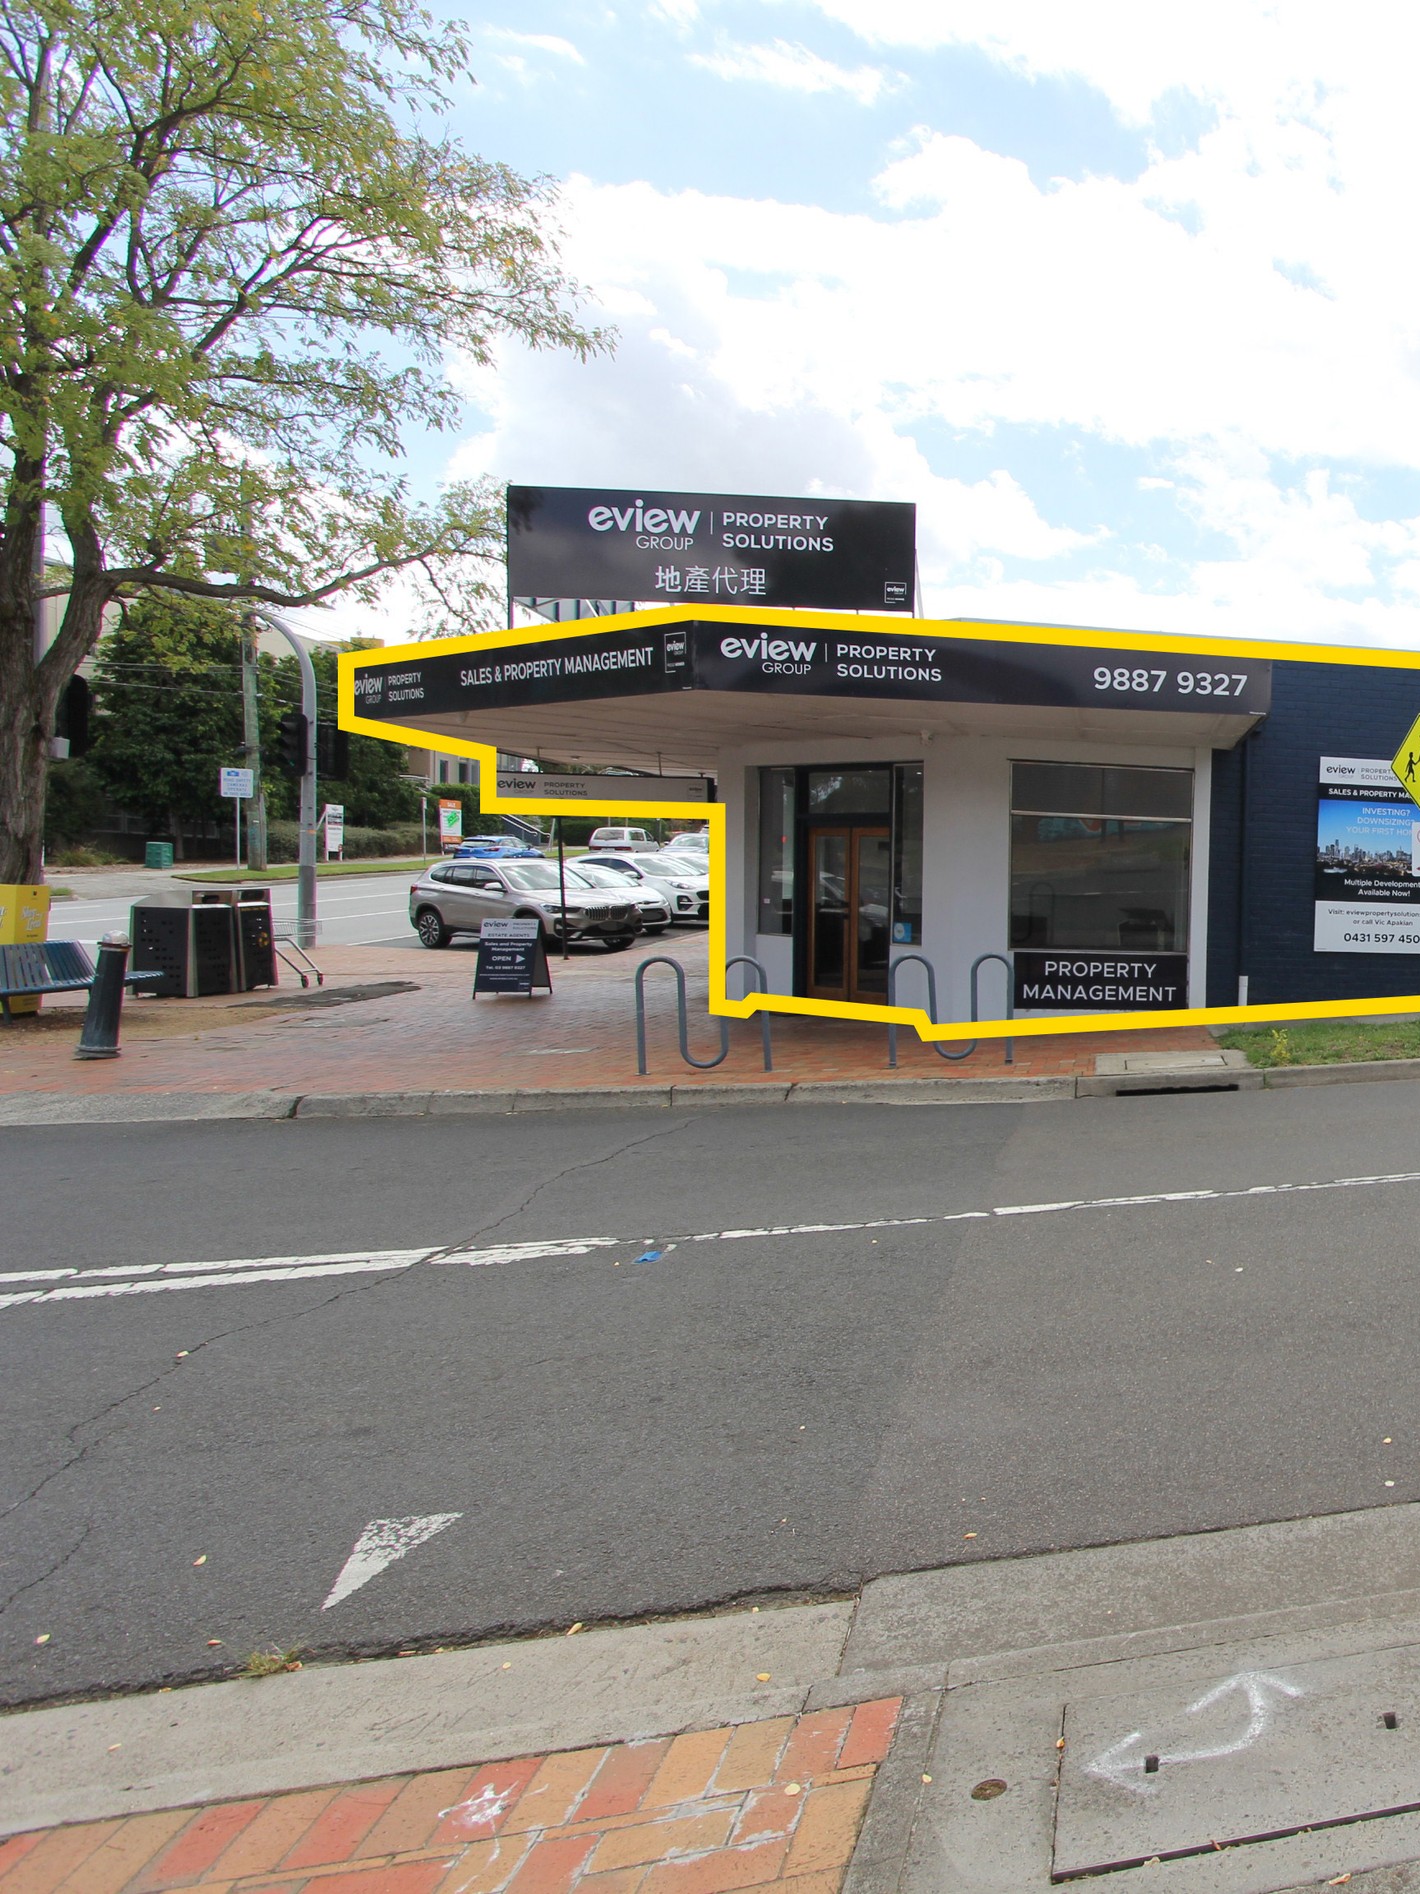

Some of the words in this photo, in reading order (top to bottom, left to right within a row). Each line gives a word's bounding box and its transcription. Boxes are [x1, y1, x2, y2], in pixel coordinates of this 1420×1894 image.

[588, 499, 701, 534] eview
[722, 512, 828, 530] PROPERTY
[636, 536, 694, 550] GROUP
[722, 533, 834, 552] SOLUTIONS
[655, 565, 766, 596] 地產代理
[720, 632, 817, 662] eview
[837, 643, 936, 662] PROPERTY
[460, 667, 492, 687] SALES
[494, 666, 502, 682] &
[504, 658, 562, 681] PROPERTY
[564, 647, 654, 675] MANAGEMENT
[762, 662, 812, 675] GROUP
[836, 663, 942, 682] SOLUTIONS
[354, 673, 383, 695] eview
[388, 672, 421, 686] PROPERTY
[1093, 667, 1167, 692] 9887
[1176, 671, 1248, 696] 9327
[388, 688, 425, 702] SOLUTIONS
[1326, 764, 1356, 774] eview
[497, 778, 536, 789] eview
[1360, 790, 1397, 798] PROPERTY
[1362, 808, 1410, 816] INVESTING?
[1344, 879, 1372, 888] Multiple
[1344, 933, 1371, 942] 0431
[1374, 934, 1395, 943] 597
[1398, 934, 1420, 943] 450
[1045, 961, 1157, 978] PROPERTY
[1022, 984, 1177, 1002] MANAGEMENT
